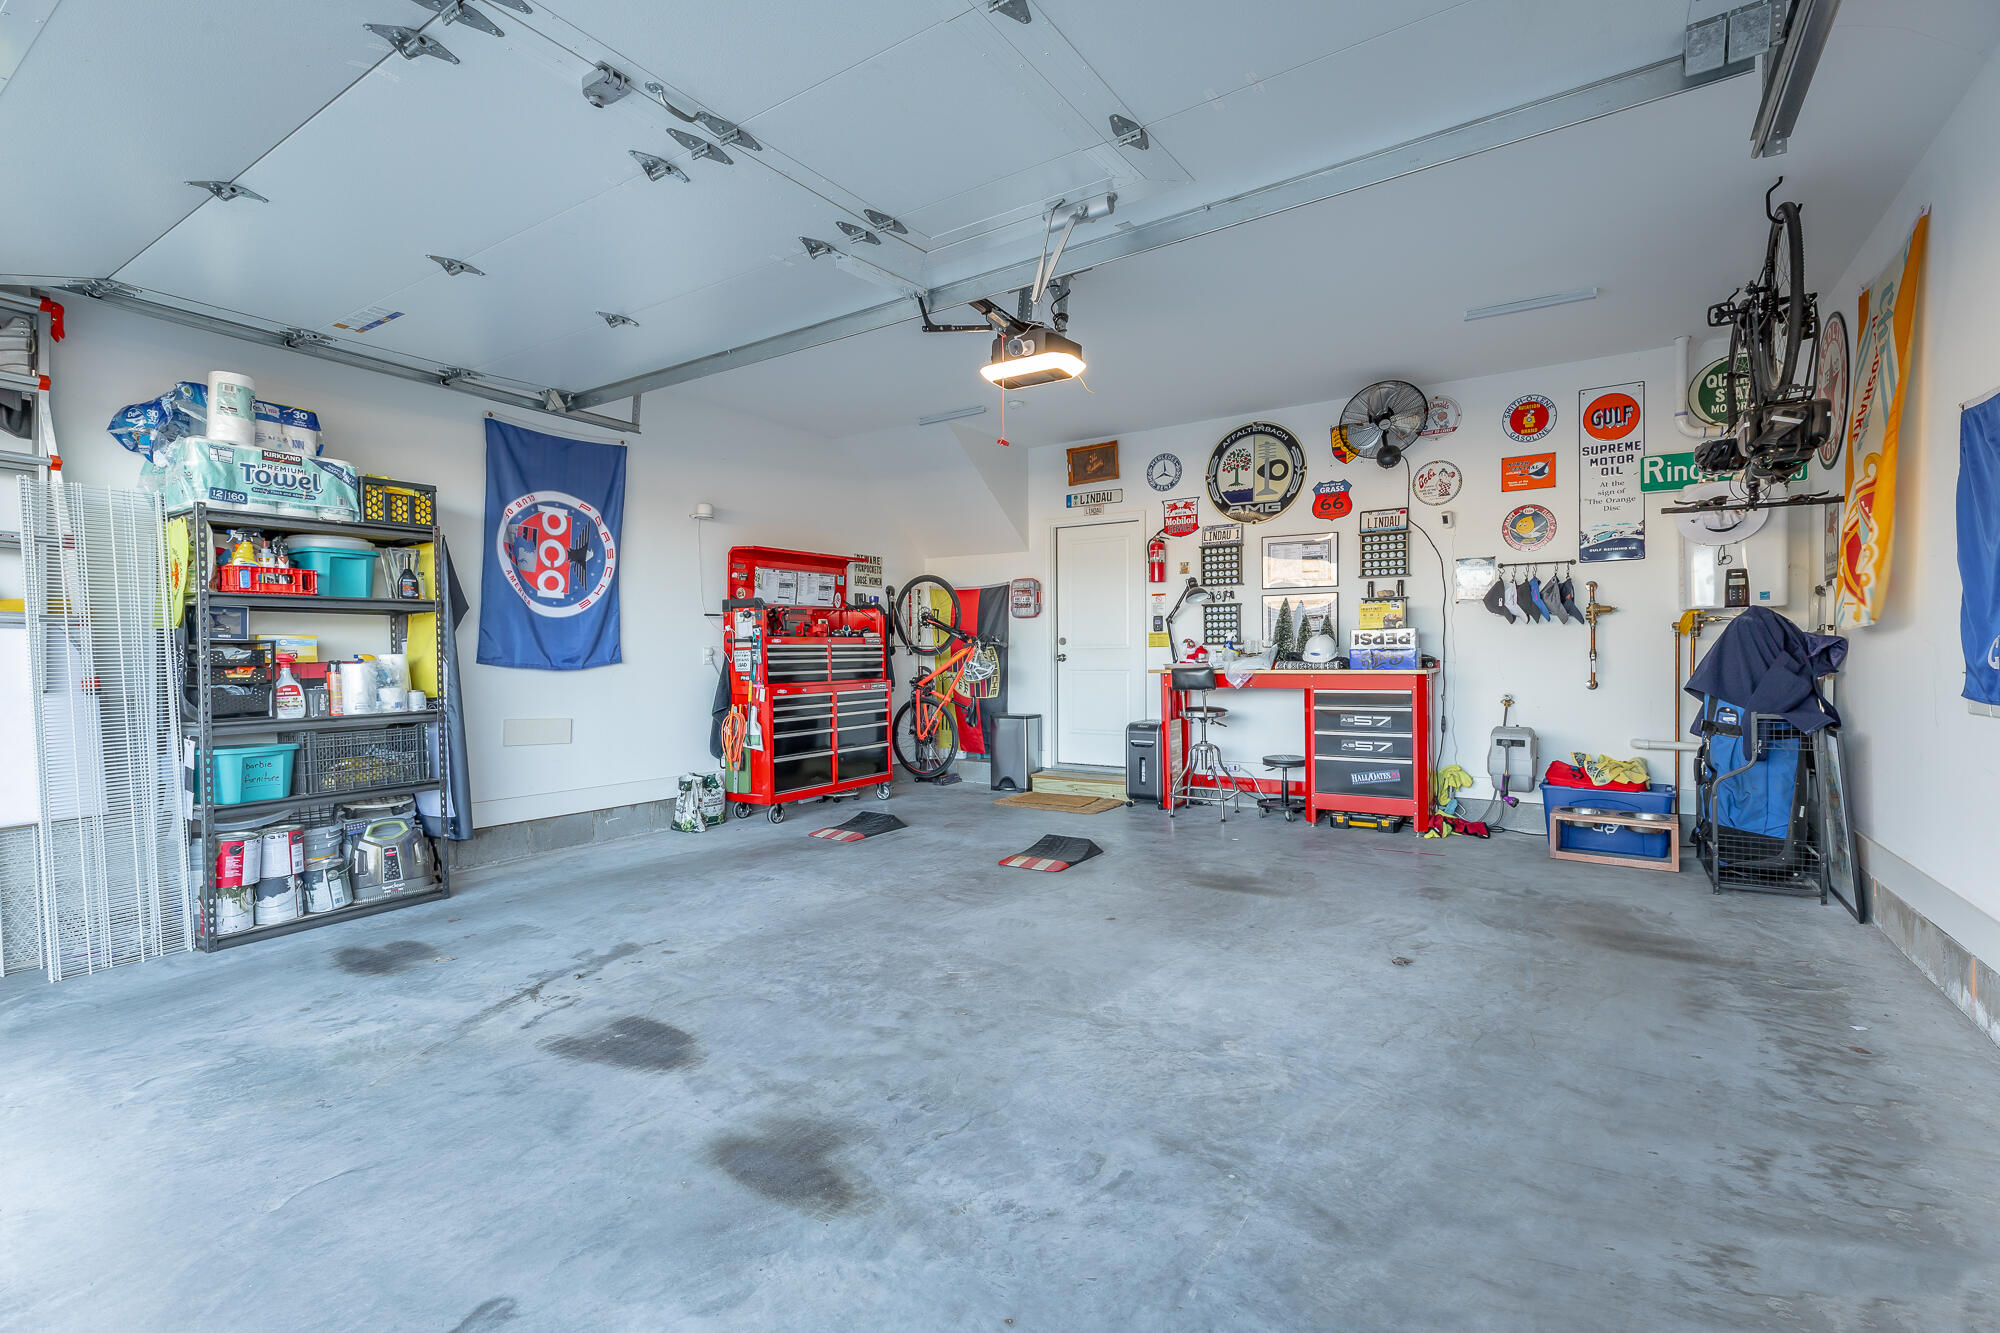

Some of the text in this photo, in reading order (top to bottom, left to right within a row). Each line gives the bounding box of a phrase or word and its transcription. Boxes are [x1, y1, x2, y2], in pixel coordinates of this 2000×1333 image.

[292, 410, 308, 420] 30
[1591, 405, 1633, 430] GULF
[1222, 425, 1289, 449] AFFALTERBACH
[1582, 440, 1642, 456] SUPREME
[263, 450, 302, 462] KIRKLAND
[1590, 454, 1635, 467] MOTOR
[261, 463, 305, 476] PREMIUM
[1601, 466, 1624, 476] OIL
[240, 462, 321, 493] Towel
[212, 489, 245, 501] 12 160
[1320, 485, 1345, 494] GRASS
[1597, 489, 1615, 497] sign
[1080, 491, 1113, 504] LINDAU
[1320, 497, 1344, 510] 66
[1227, 501, 1282, 515] AMG
[1165, 515, 1196, 526] Mobiloil
[1367, 516, 1400, 529] LINDAU
[1203, 530, 1231, 541] LINDAU
[504, 494, 536, 606] CLUB OF AMERICA
[579, 502, 614, 610] PORSCHE
[855, 575, 868, 585] LOOSE
[1355, 633, 1410, 645] PEPSI
